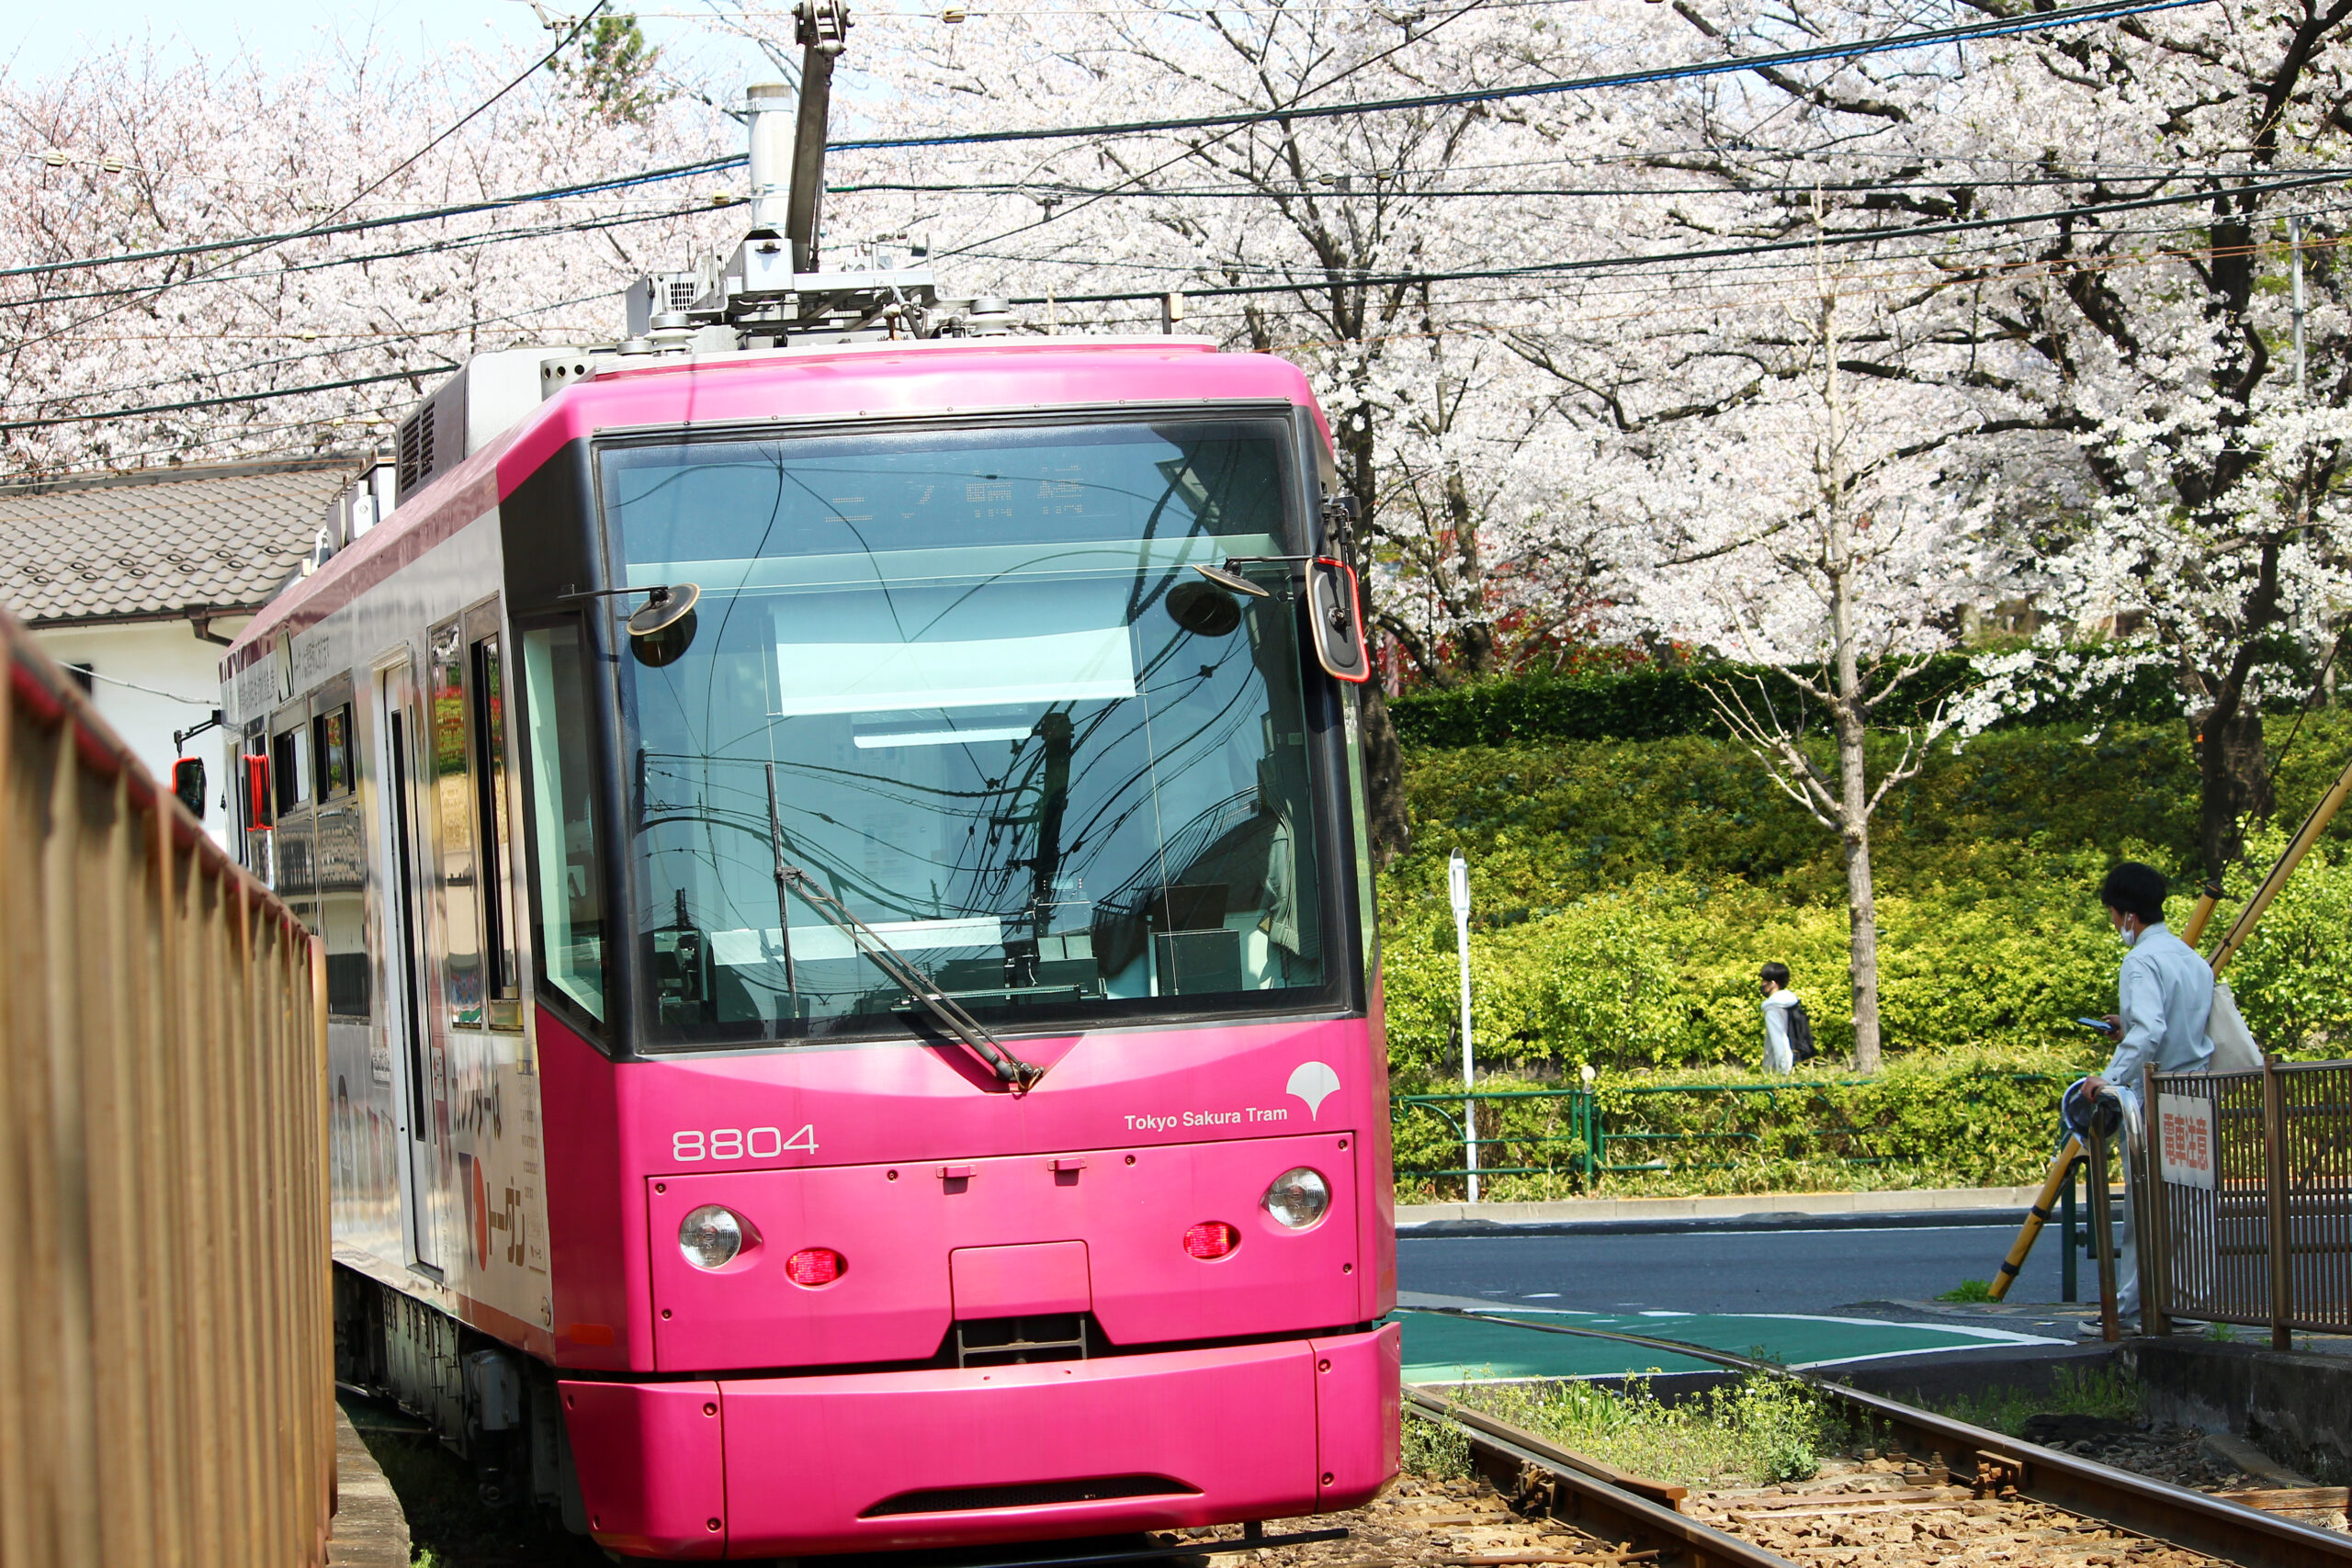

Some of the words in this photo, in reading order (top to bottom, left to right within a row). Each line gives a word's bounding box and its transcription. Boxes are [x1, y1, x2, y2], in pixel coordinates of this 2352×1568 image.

[1124, 1114, 1178, 1133] Tokyo
[1182, 1111, 1241, 1127] Sakura
[1245, 1107, 1288, 1122] Tram
[673, 1123, 820, 1162] 8804
[2164, 1112, 2209, 1170] 電車注意
